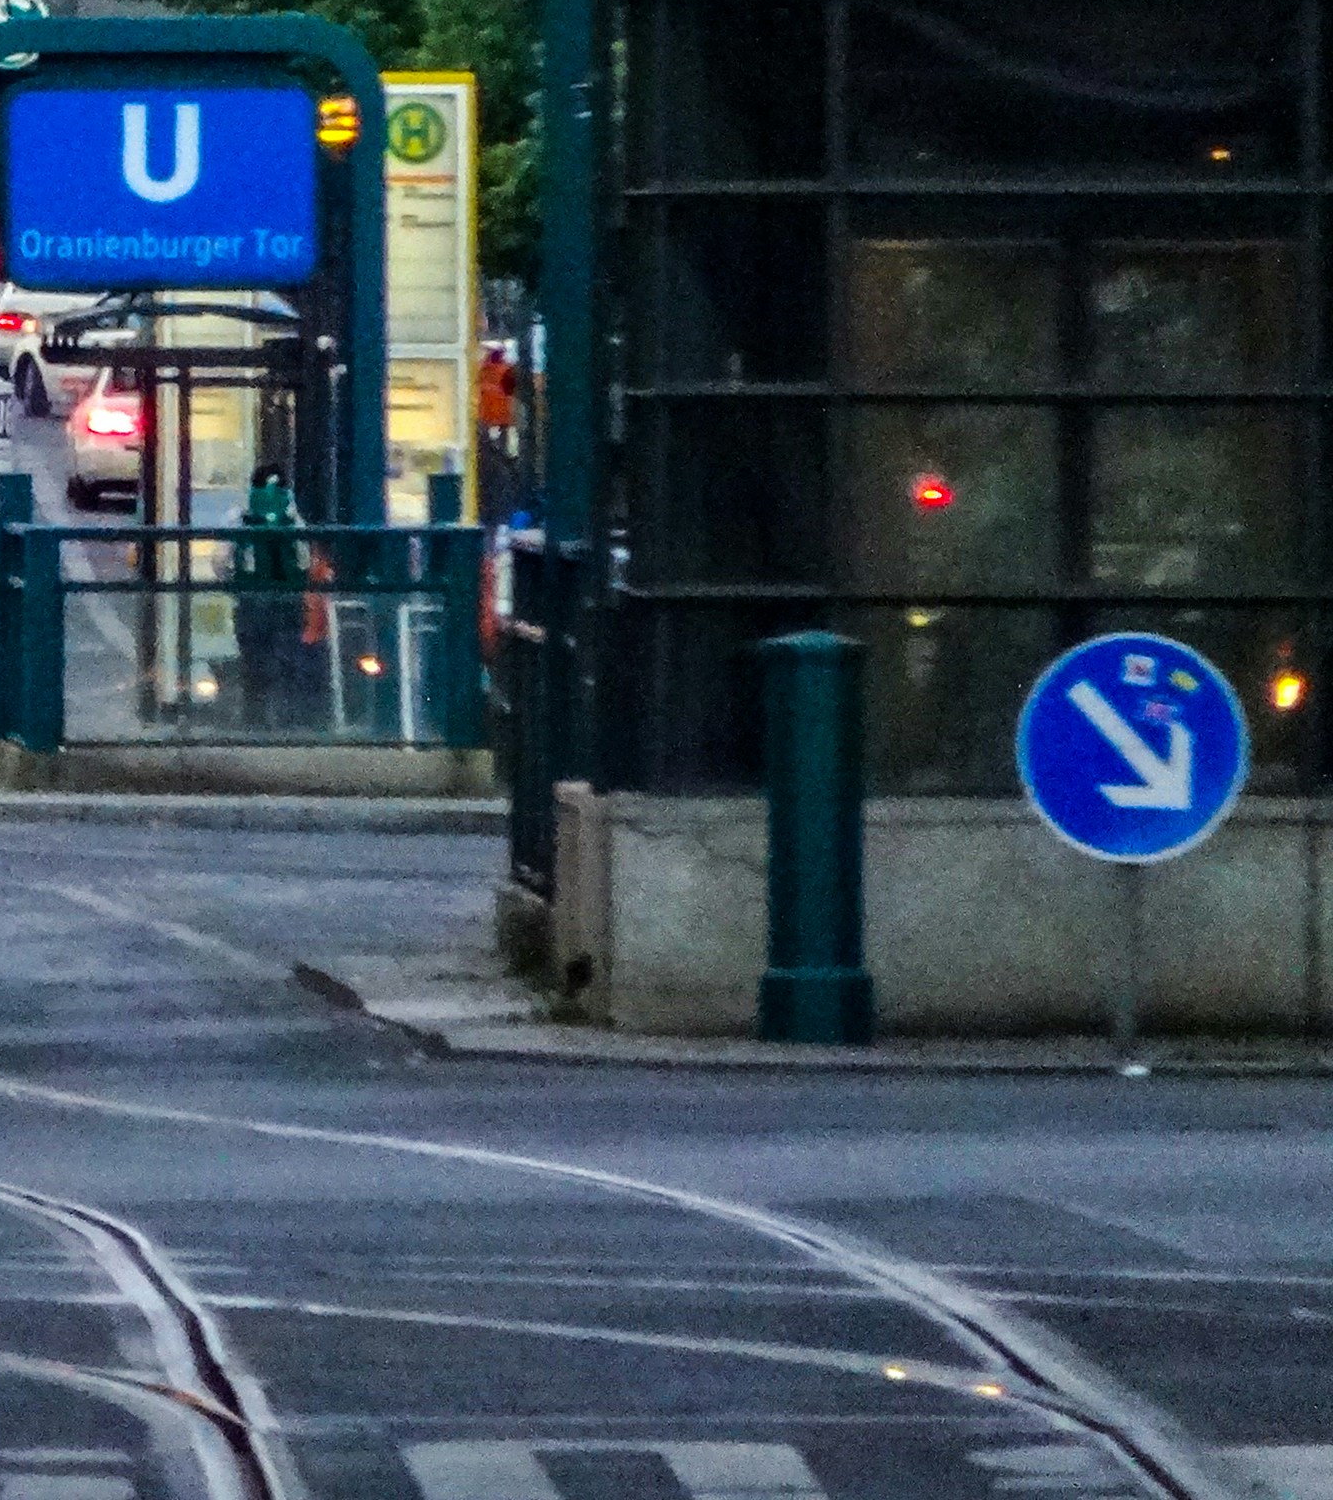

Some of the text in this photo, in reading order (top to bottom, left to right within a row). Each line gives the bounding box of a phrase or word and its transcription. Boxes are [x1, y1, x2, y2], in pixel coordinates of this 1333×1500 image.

[123, 103, 200, 202] U
[20, 228, 304, 267] Oranienburger Tor
